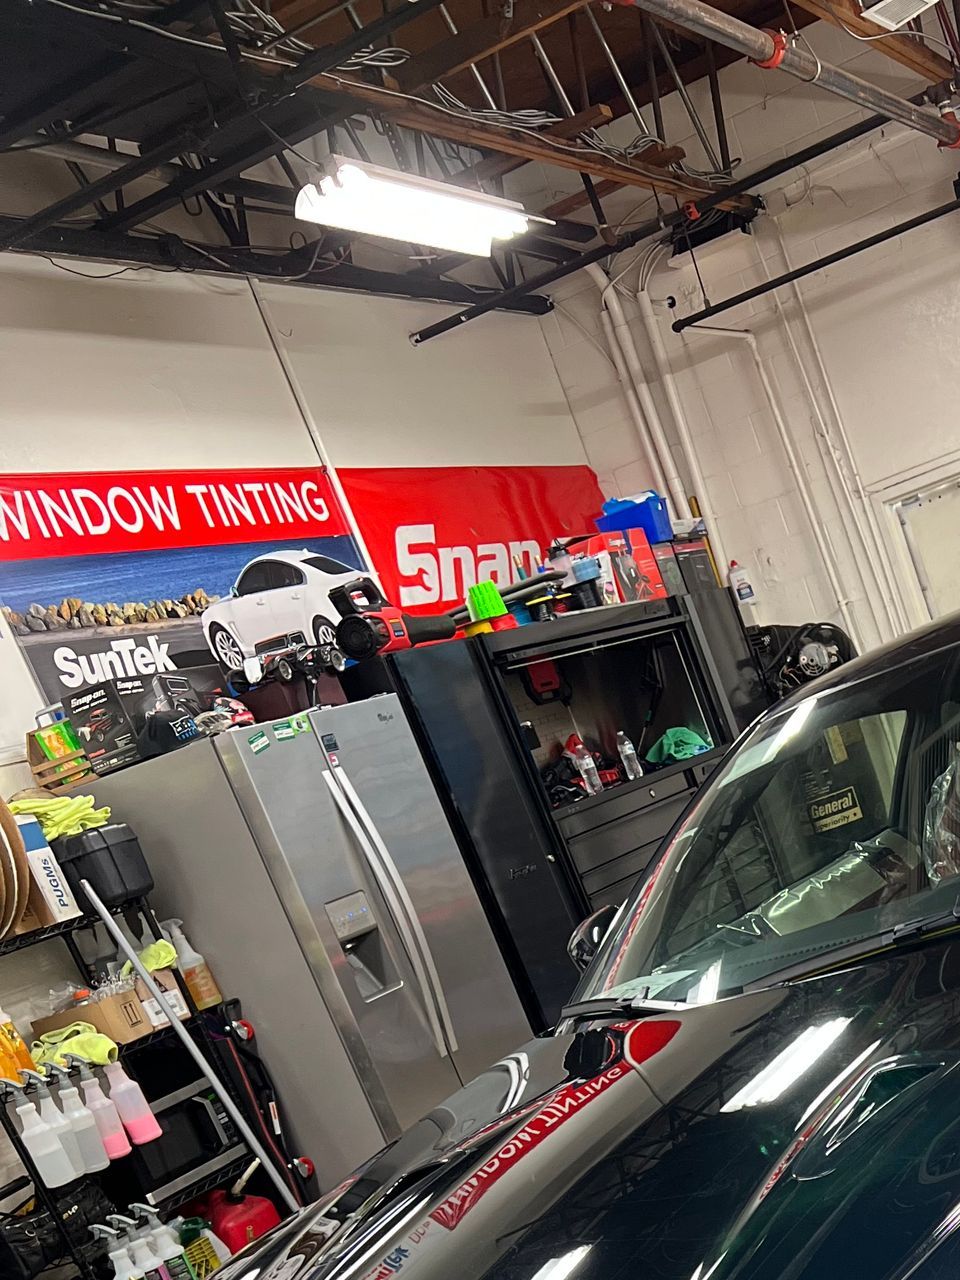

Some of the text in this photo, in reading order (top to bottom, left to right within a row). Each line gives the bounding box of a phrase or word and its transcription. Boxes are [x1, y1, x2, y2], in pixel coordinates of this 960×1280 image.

[0, 480, 331, 542] WINDOW TINTING
[53, 634, 179, 689] SunTek
[70, 688, 106, 708] Snap-on
[810, 792, 853, 820] General
[41, 858, 69, 908] PUGMS
